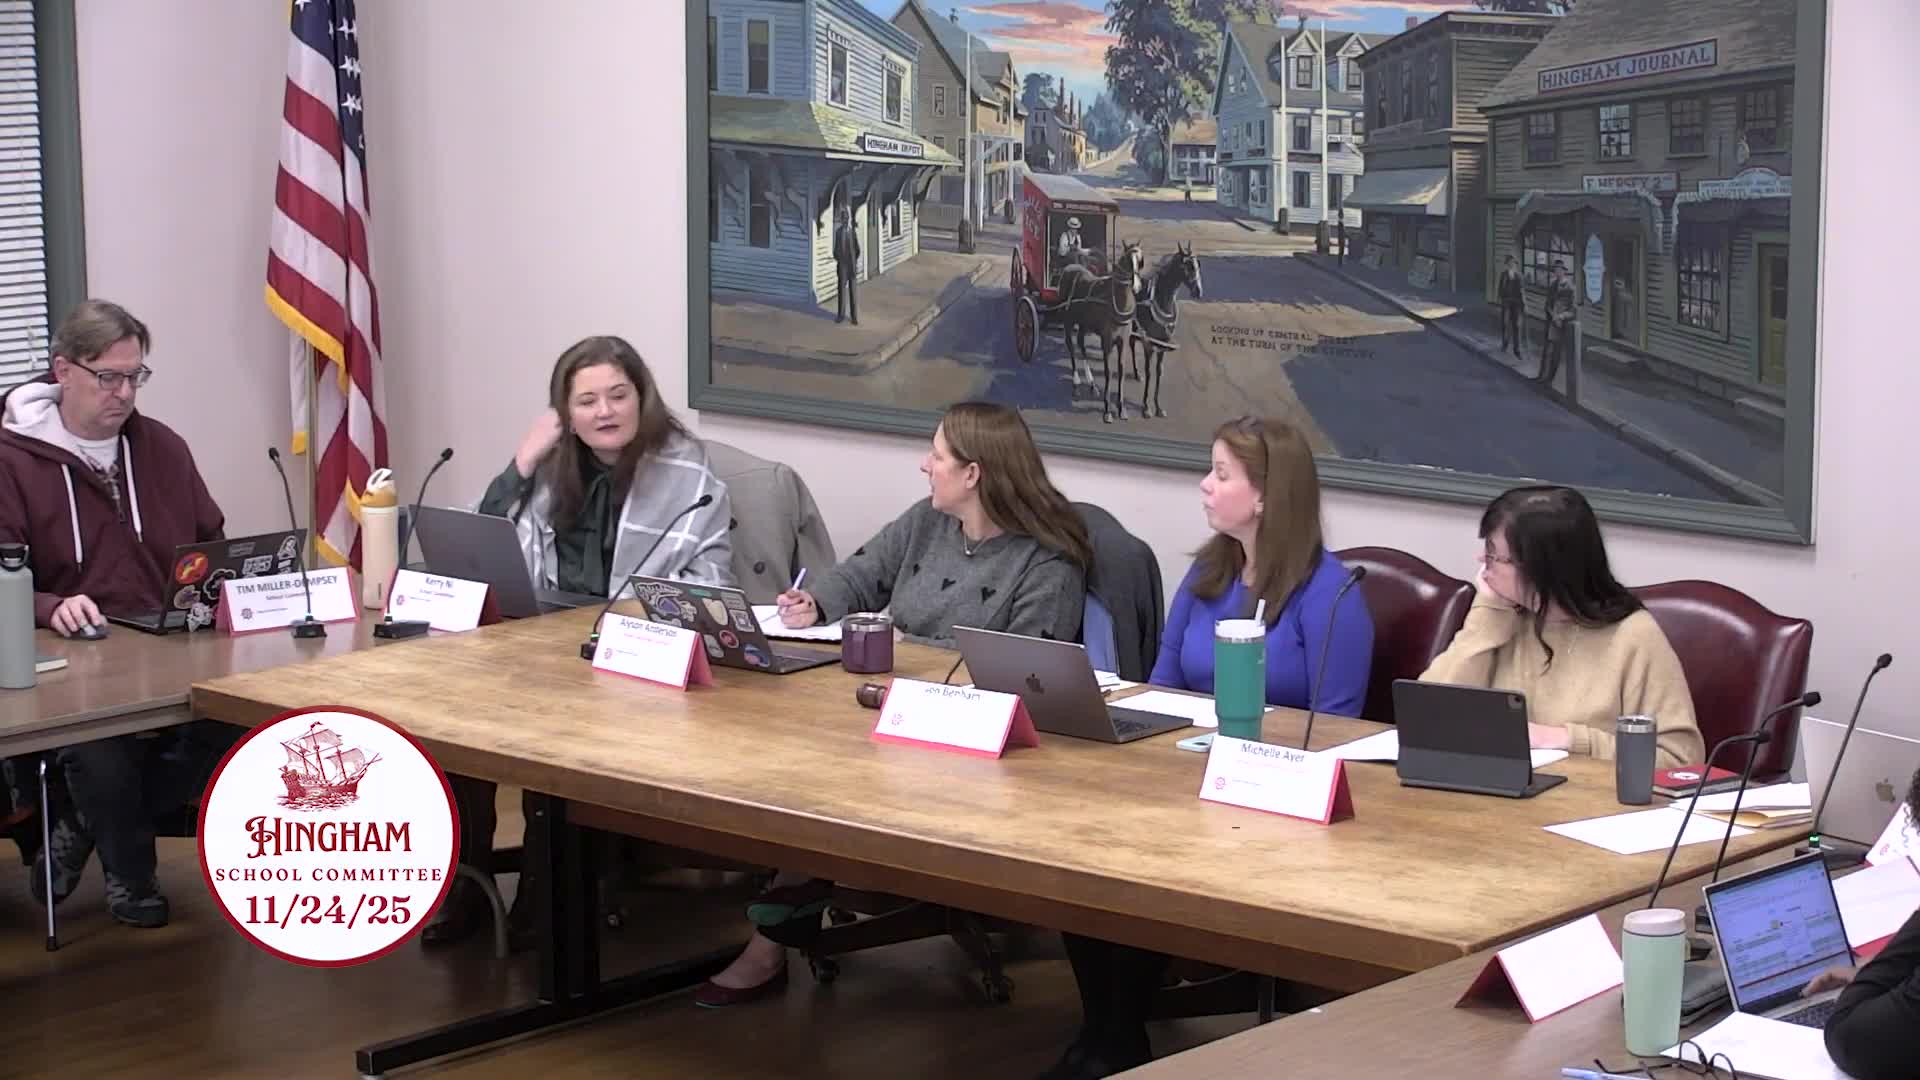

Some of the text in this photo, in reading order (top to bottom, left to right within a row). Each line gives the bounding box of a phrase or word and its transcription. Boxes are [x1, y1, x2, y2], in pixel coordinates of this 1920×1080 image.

[1541, 47, 1711, 89] HINGHAM JOURNAL
[867, 138, 898, 152] HINGHAM
[1211, 325, 1249, 336] LOOKING
[1253, 328, 1265, 337] UP
[1268, 330, 1313, 342] CENTRAL
[1211, 336, 1224, 345] AT
[1228, 338, 1246, 347] THE
[1249, 339, 1277, 350] TURN
[1280, 342, 1292, 351] OF
[235, 575, 338, 595] TIM MILLER-DMPSEY
[1241, 743, 1281, 759] Michelle
